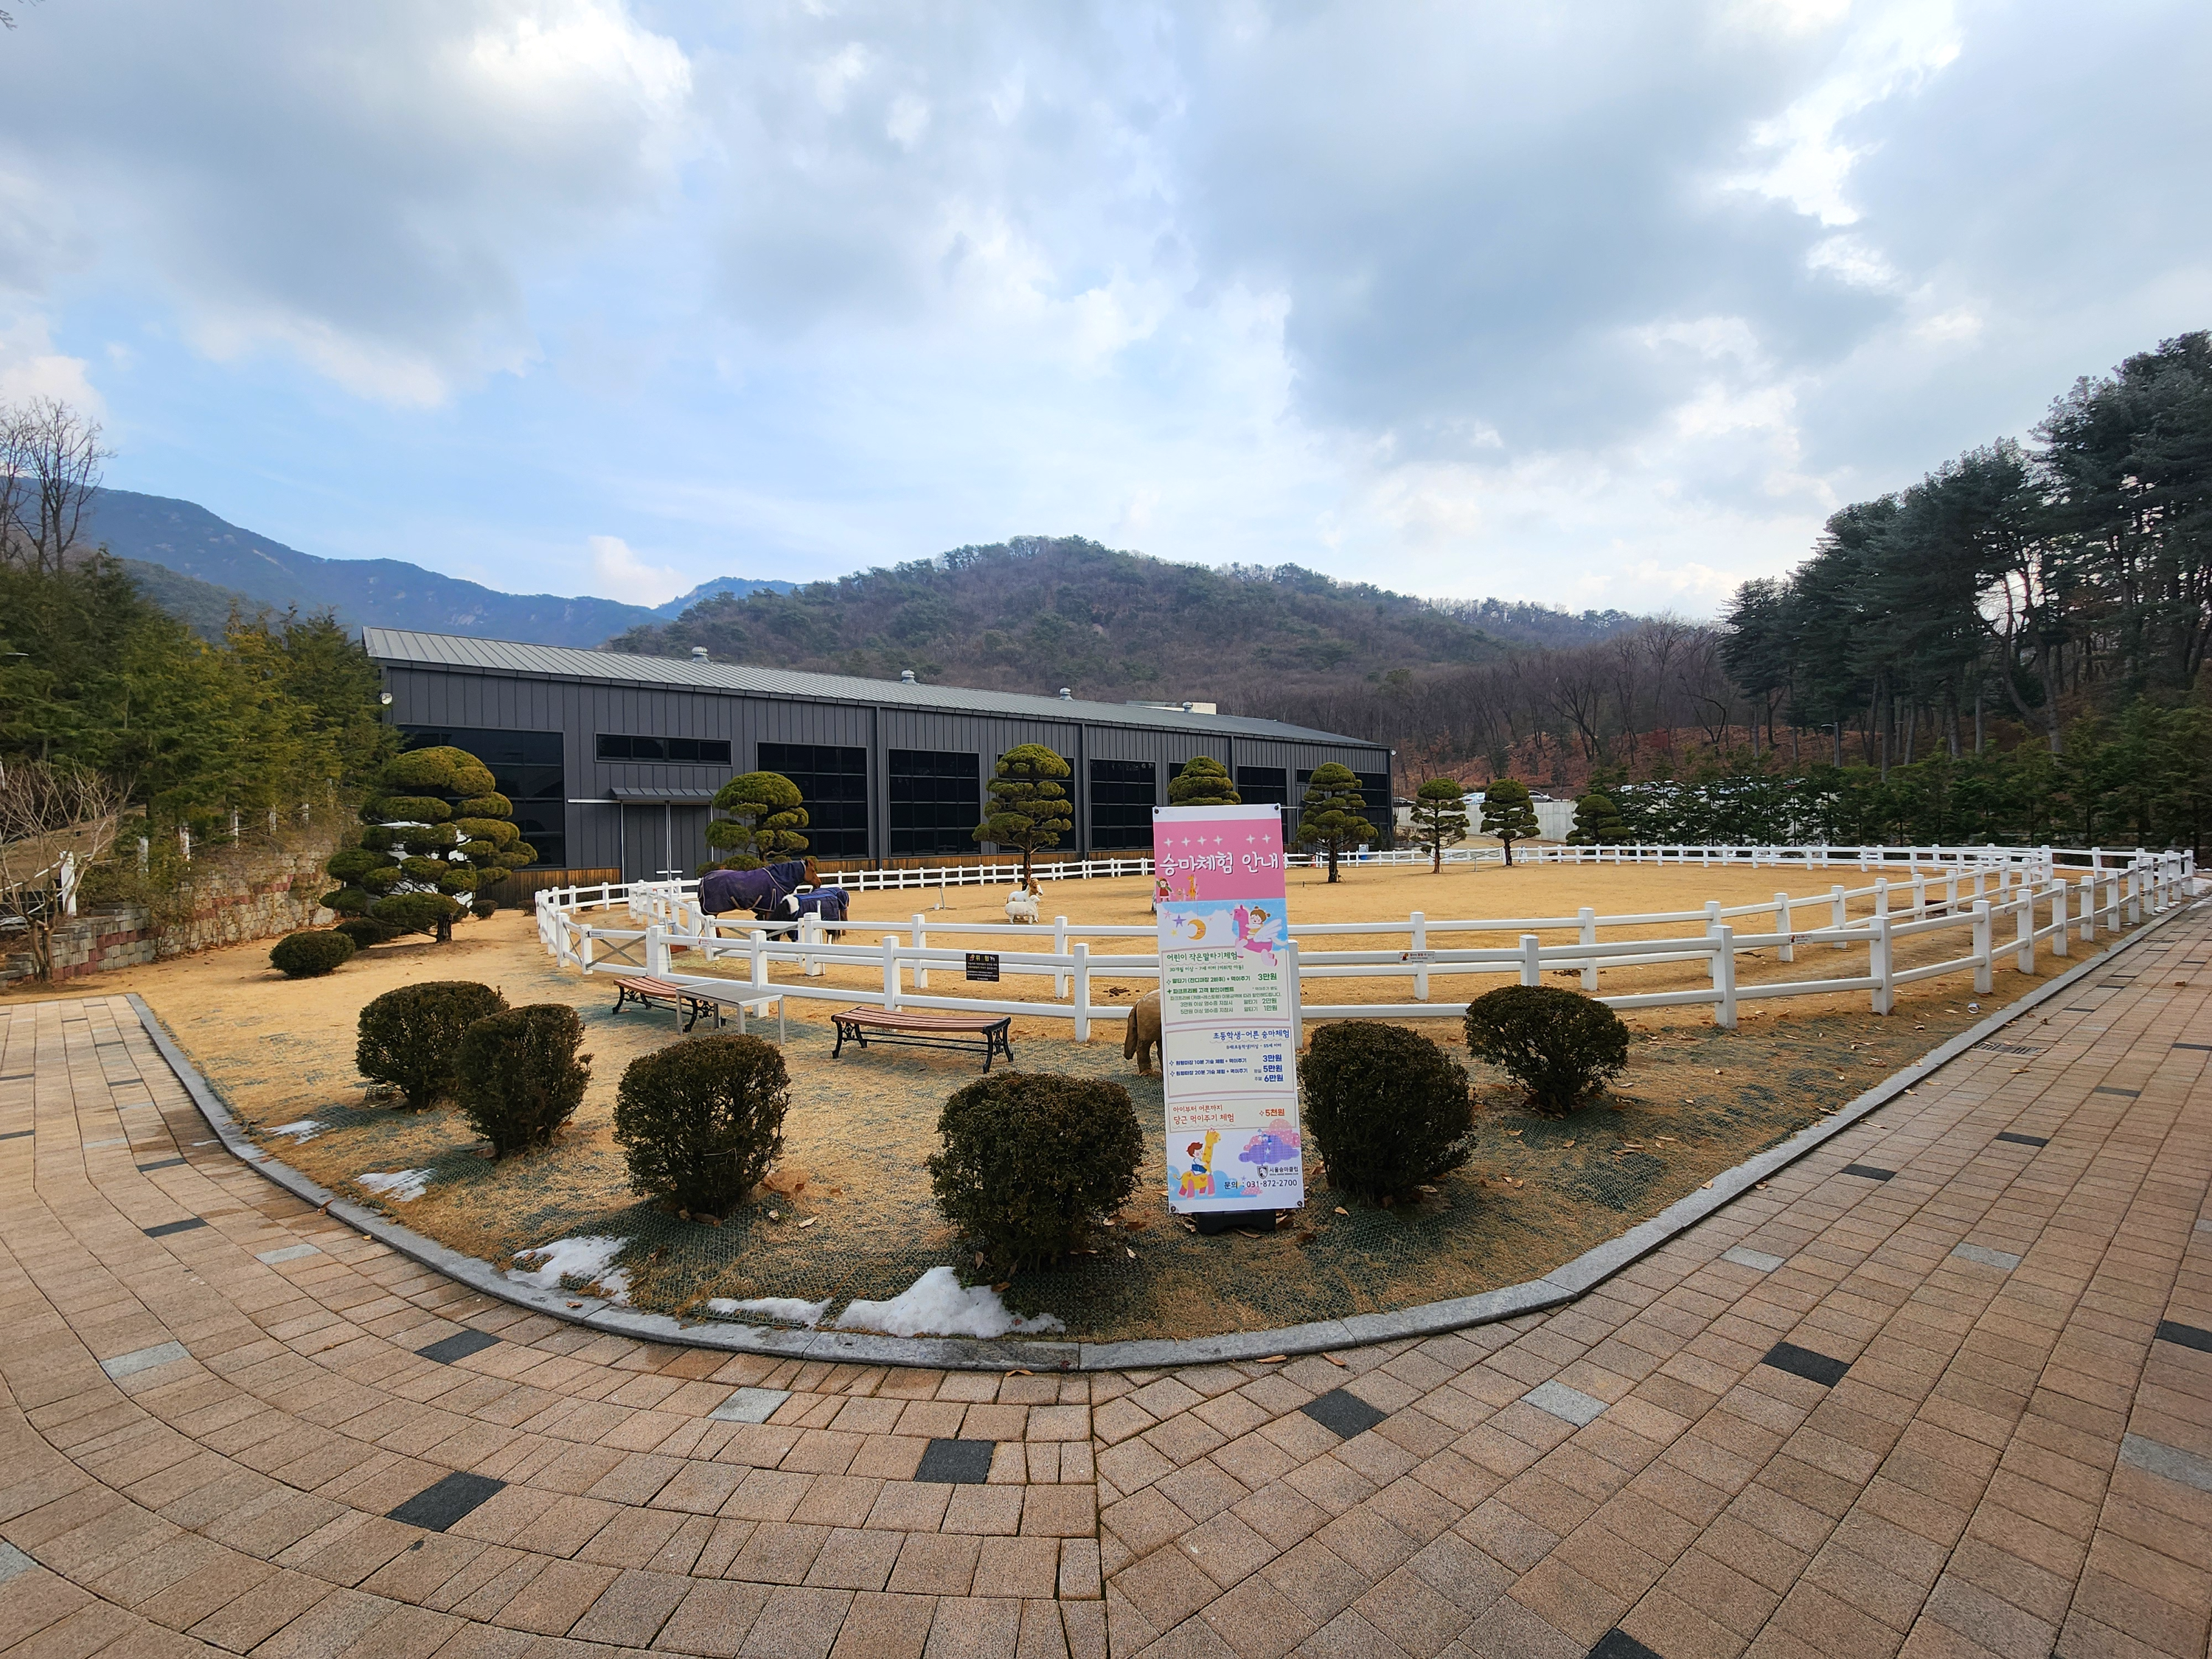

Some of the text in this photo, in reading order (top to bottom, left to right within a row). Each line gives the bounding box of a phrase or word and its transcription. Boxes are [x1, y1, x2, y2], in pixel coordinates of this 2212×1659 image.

[1159, 851, 1279, 876] 승마체험 안내
[1166, 951, 1237, 962] 어린이 작은말타기체험
[1257, 973, 1278, 981] 3만원
[1213, 1029, 1290, 1040] 초등학생-어른 승마체험
[1262, 1054, 1282, 1062] 3만원
[1263, 1064, 1283, 1073] 5만원
[1264, 1074, 1284, 1082] 6만원
[1198, 1105, 1222, 1113] 어른까지
[1265, 1108, 1285, 1117] 5천원
[1173, 1113, 1234, 1125] 당근 먹이주기 체험
[1224, 1181, 1238, 1189] 문의
[1246, 1179, 1298, 1188] 031-872-2700
